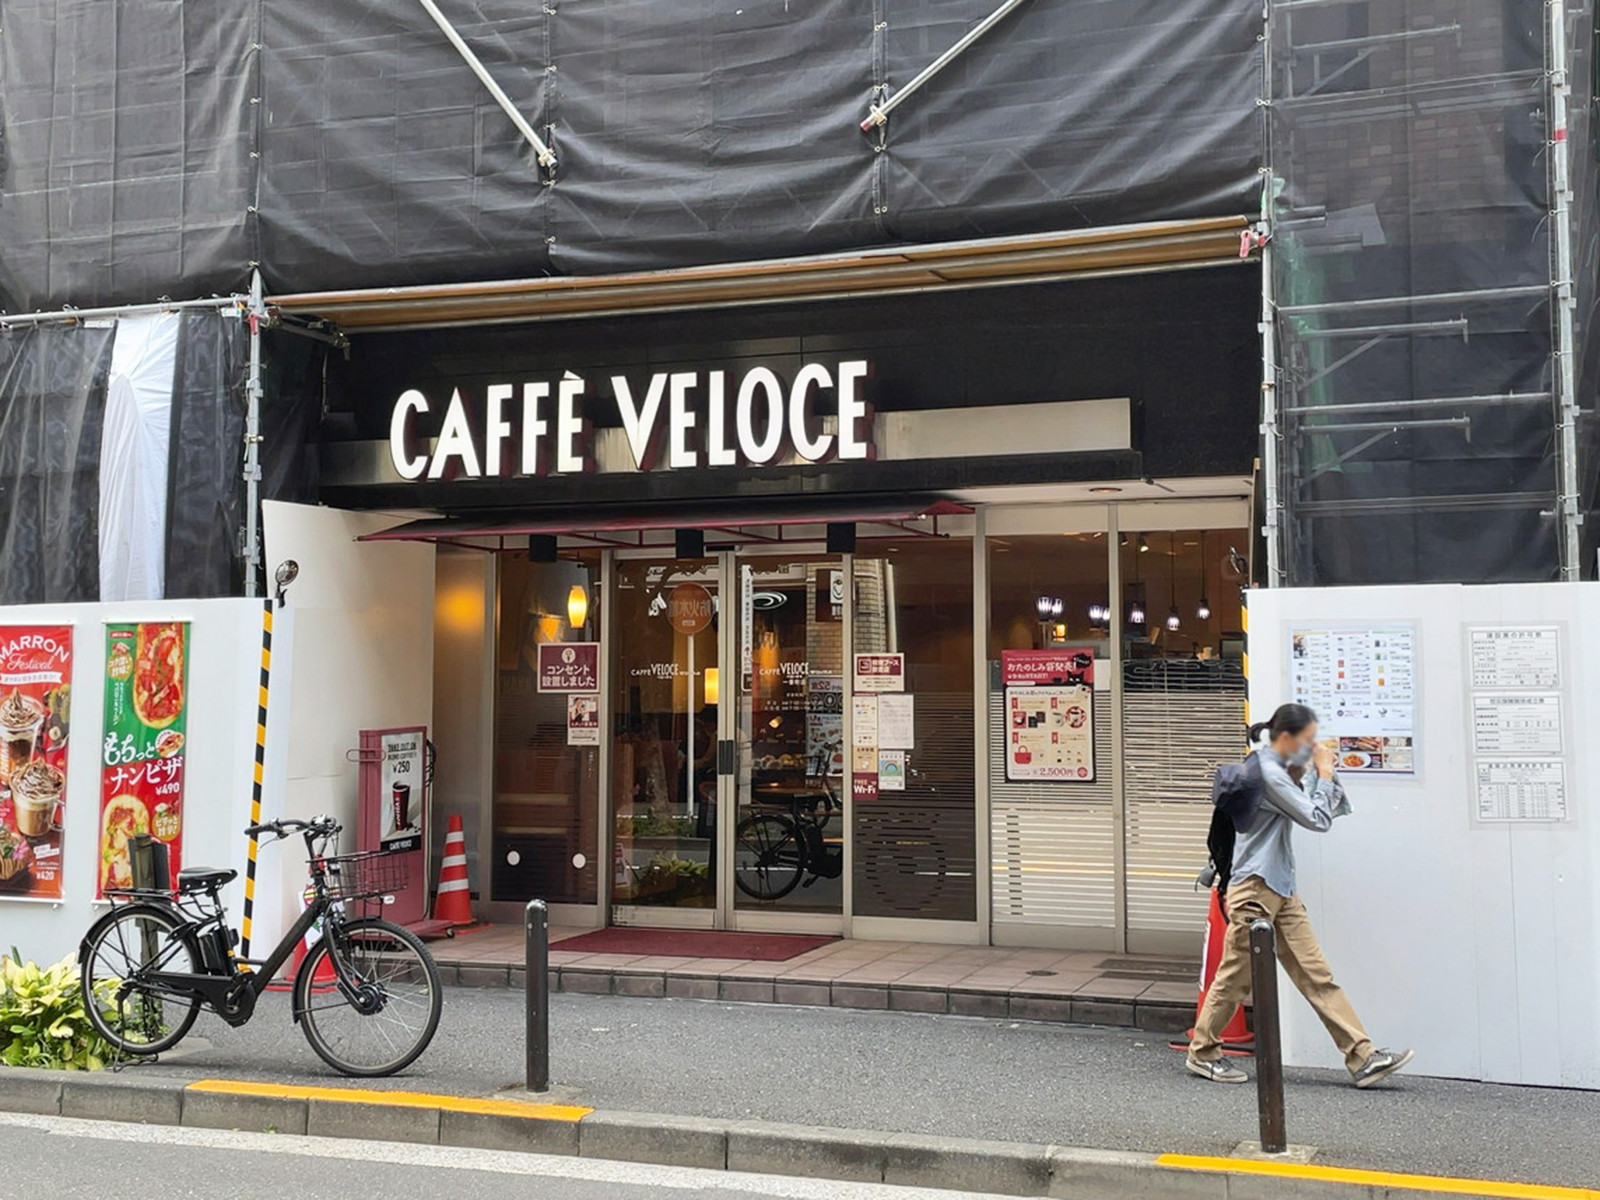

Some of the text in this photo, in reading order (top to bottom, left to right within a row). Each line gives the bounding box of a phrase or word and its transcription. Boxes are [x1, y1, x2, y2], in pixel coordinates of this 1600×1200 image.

[390, 360, 868, 480] CAFFÈ VELOCE
[0, 635, 70, 664] MARRON
[7, 653, 56, 671] Festival
[547, 664, 590, 675] コンセント
[651, 663, 680, 676] VELOCE
[780, 662, 809, 675] VELOCE
[542, 676, 596, 687] 設置しました
[104, 732, 155, 765] もちっと
[110, 756, 184, 795] ナンピザ
